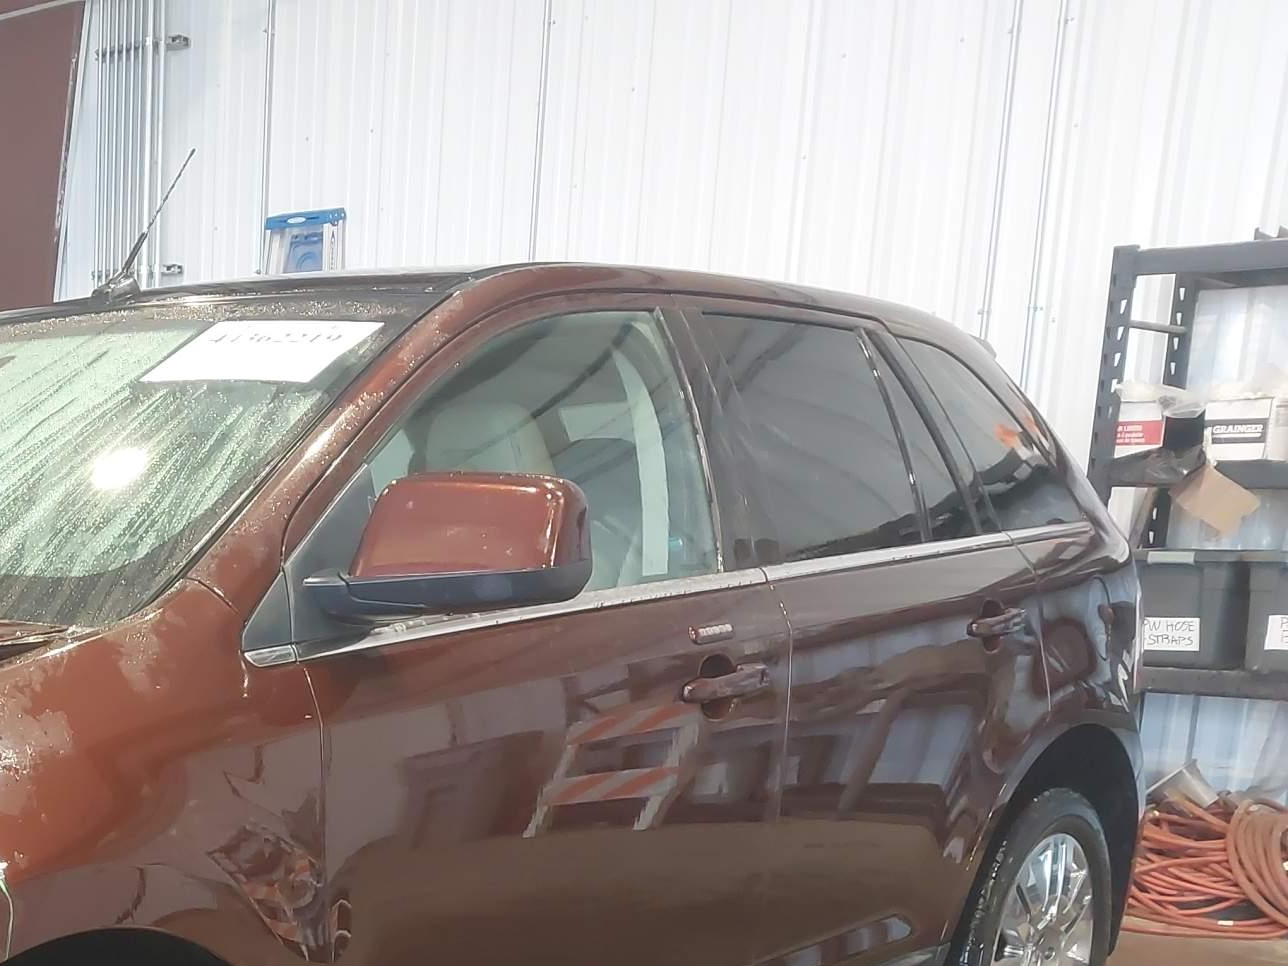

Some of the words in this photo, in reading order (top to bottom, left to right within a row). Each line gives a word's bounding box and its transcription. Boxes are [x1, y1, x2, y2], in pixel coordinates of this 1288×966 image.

[1212, 424, 1264, 434] GRAINGER
[1166, 620, 1195, 632] HOSE
[1147, 633, 1194, 646] STRAPS
